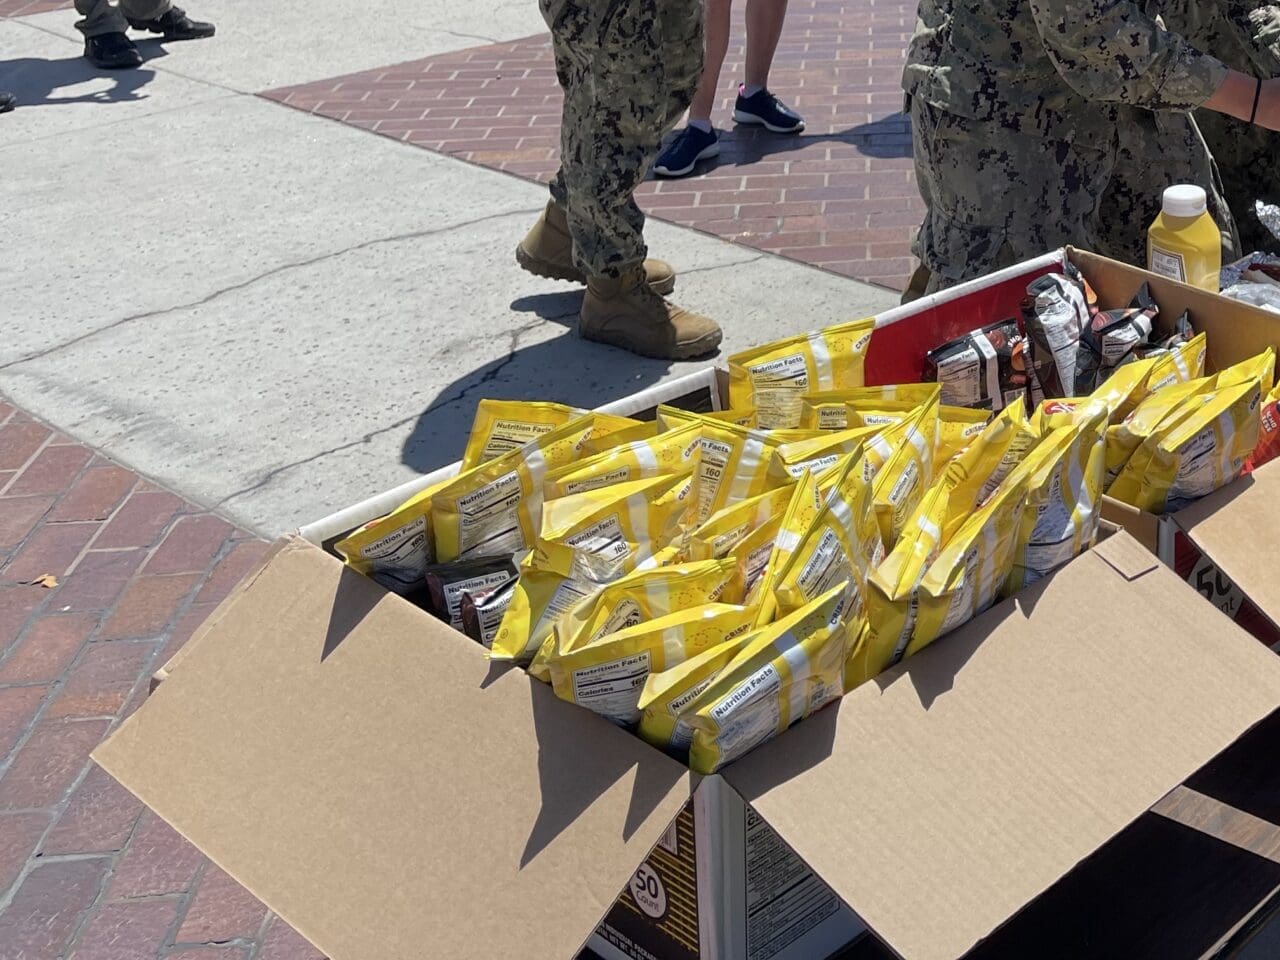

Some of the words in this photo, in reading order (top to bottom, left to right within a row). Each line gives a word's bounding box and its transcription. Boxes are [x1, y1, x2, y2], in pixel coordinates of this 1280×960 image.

[752, 361, 783, 375] Nutrition
[784, 355, 803, 366] Facts
[496, 422, 531, 432] Nutrition
[488, 442, 516, 450] Calories
[708, 443, 729, 453] Facts
[705, 467, 721, 478] 160
[460, 484, 499, 507] Nutrition
[496, 475, 517, 489] Facts
[365, 533, 402, 554] Nutrition
[402, 520, 424, 534] Facts
[411, 534, 425, 548] 160
[569, 527, 599, 546] Nutrition
[597, 518, 616, 531] Facts
[613, 542, 627, 554] 160
[800, 552, 823, 586] Nutrition
[819, 532, 834, 554] Facts
[449, 581, 484, 593] Nutrition
[485, 574, 507, 585] Facts
[576, 661, 620, 676] Nutrition
[621, 655, 648, 667] Facts
[578, 686, 613, 697] Calories
[715, 684, 752, 718] Nutrition
[750, 667, 774, 689] Facts
[635, 870, 659, 899] 50
[635, 889, 660, 913] Count
